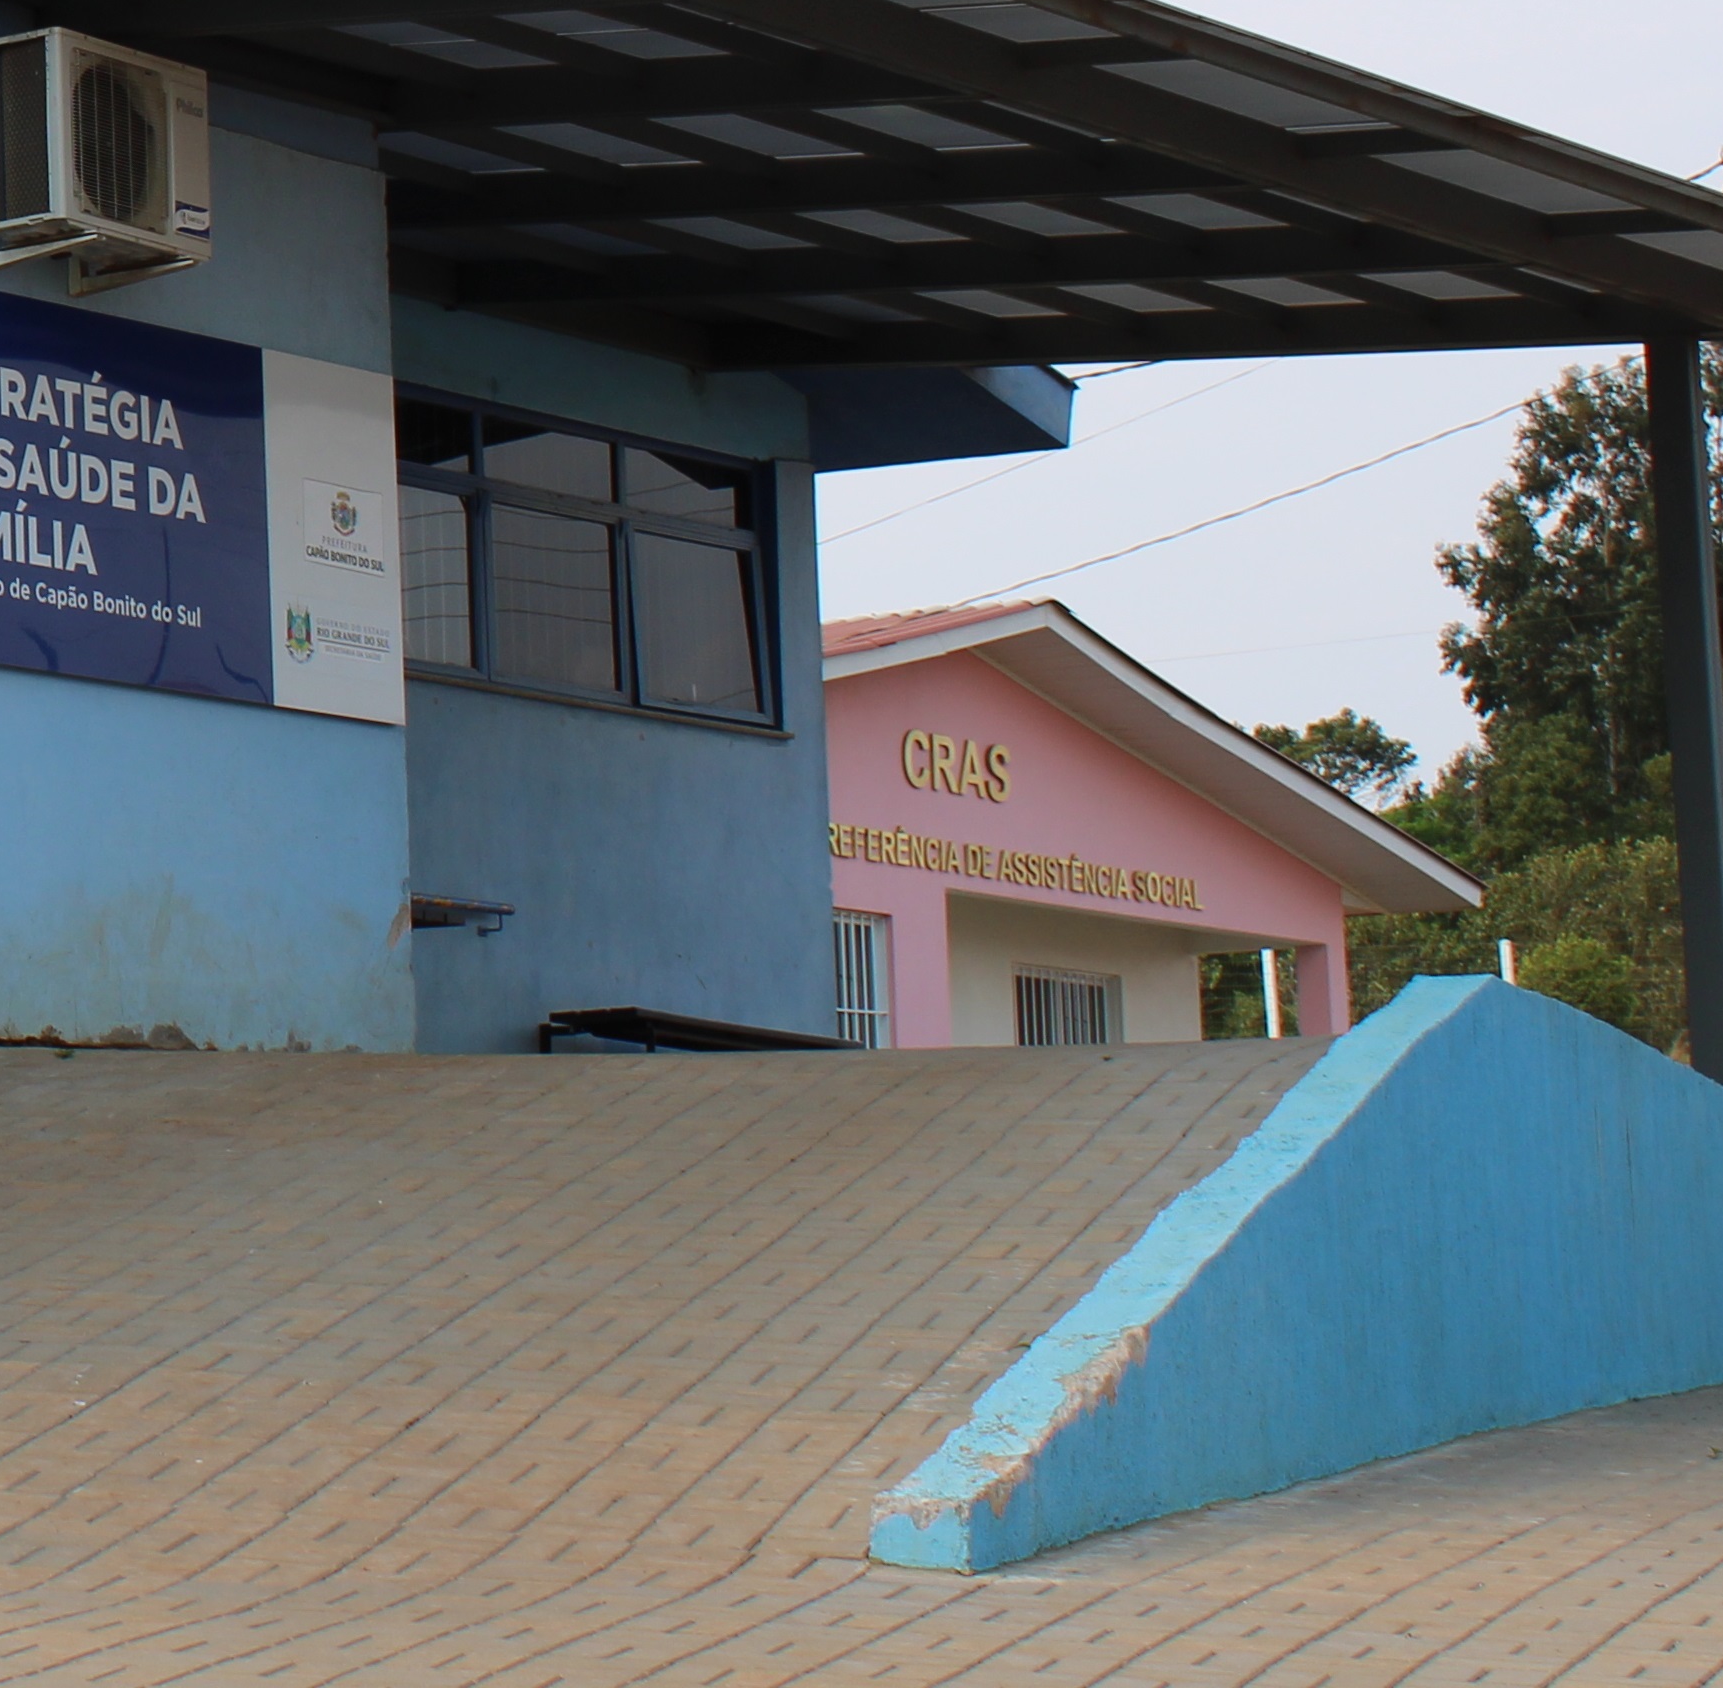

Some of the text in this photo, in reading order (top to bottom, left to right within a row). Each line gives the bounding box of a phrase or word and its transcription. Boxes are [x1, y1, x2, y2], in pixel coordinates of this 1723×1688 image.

[147, 465, 207, 523] DA
[306, 544, 384, 572] CAPÃO BONITO DO SUL
[321, 535, 368, 552] PREFEITURA
[10, 577, 30, 600] de
[35, 582, 88, 610] Capão
[93, 590, 147, 618] Bonito
[151, 600, 172, 623] do
[177, 605, 201, 628] Sul
[316, 627, 389, 650] RIO GRANDE DO SUL
[901, 728, 1011, 803] CRAS
[964, 843, 992, 879] DE
[996, 848, 1131, 900] ASSISTÊNCIA
[1133, 869, 1204, 911] SOCIAL
